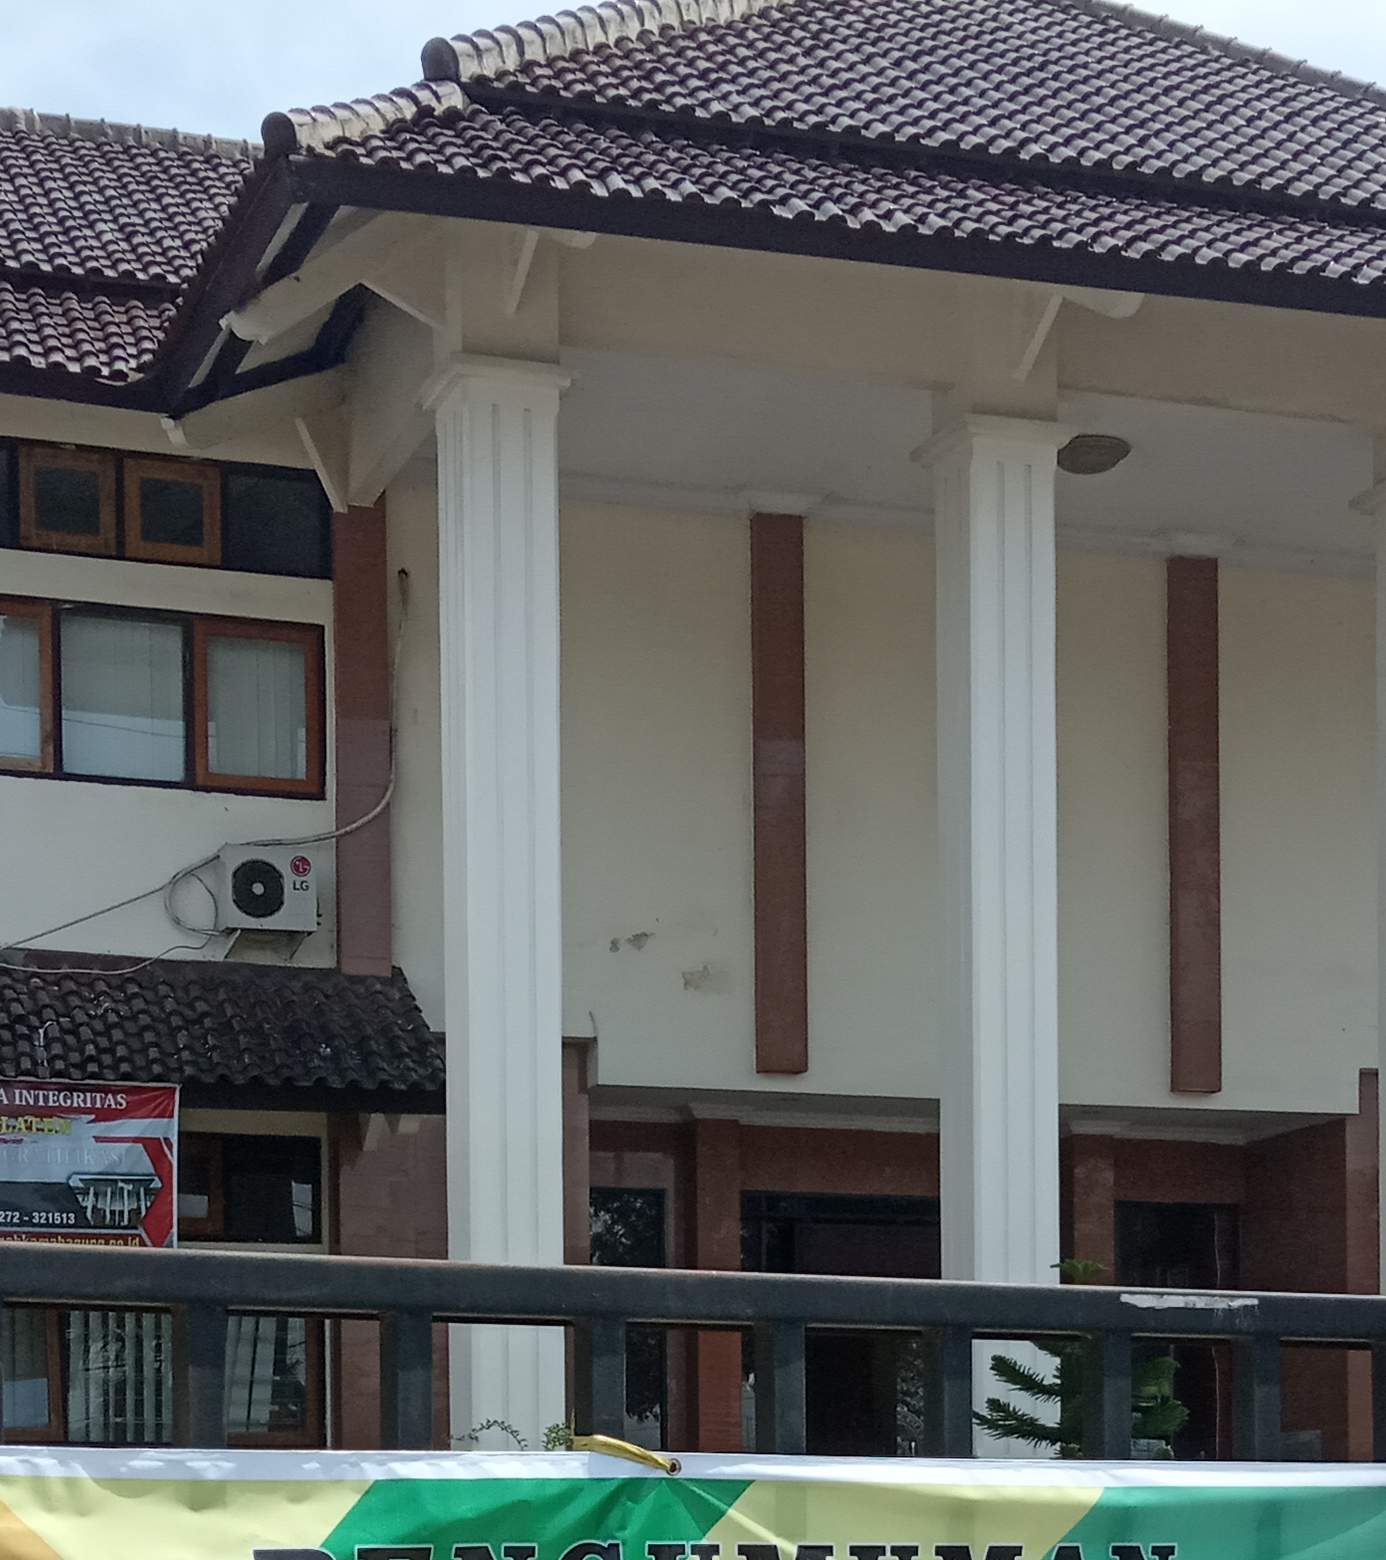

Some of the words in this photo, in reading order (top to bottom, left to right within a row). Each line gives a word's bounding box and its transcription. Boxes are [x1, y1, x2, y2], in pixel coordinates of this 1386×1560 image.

[293, 880, 309, 891] LG
[13, 1089, 127, 1110] INTEGRITAS
[32, 1212, 76, 1225] 321513
